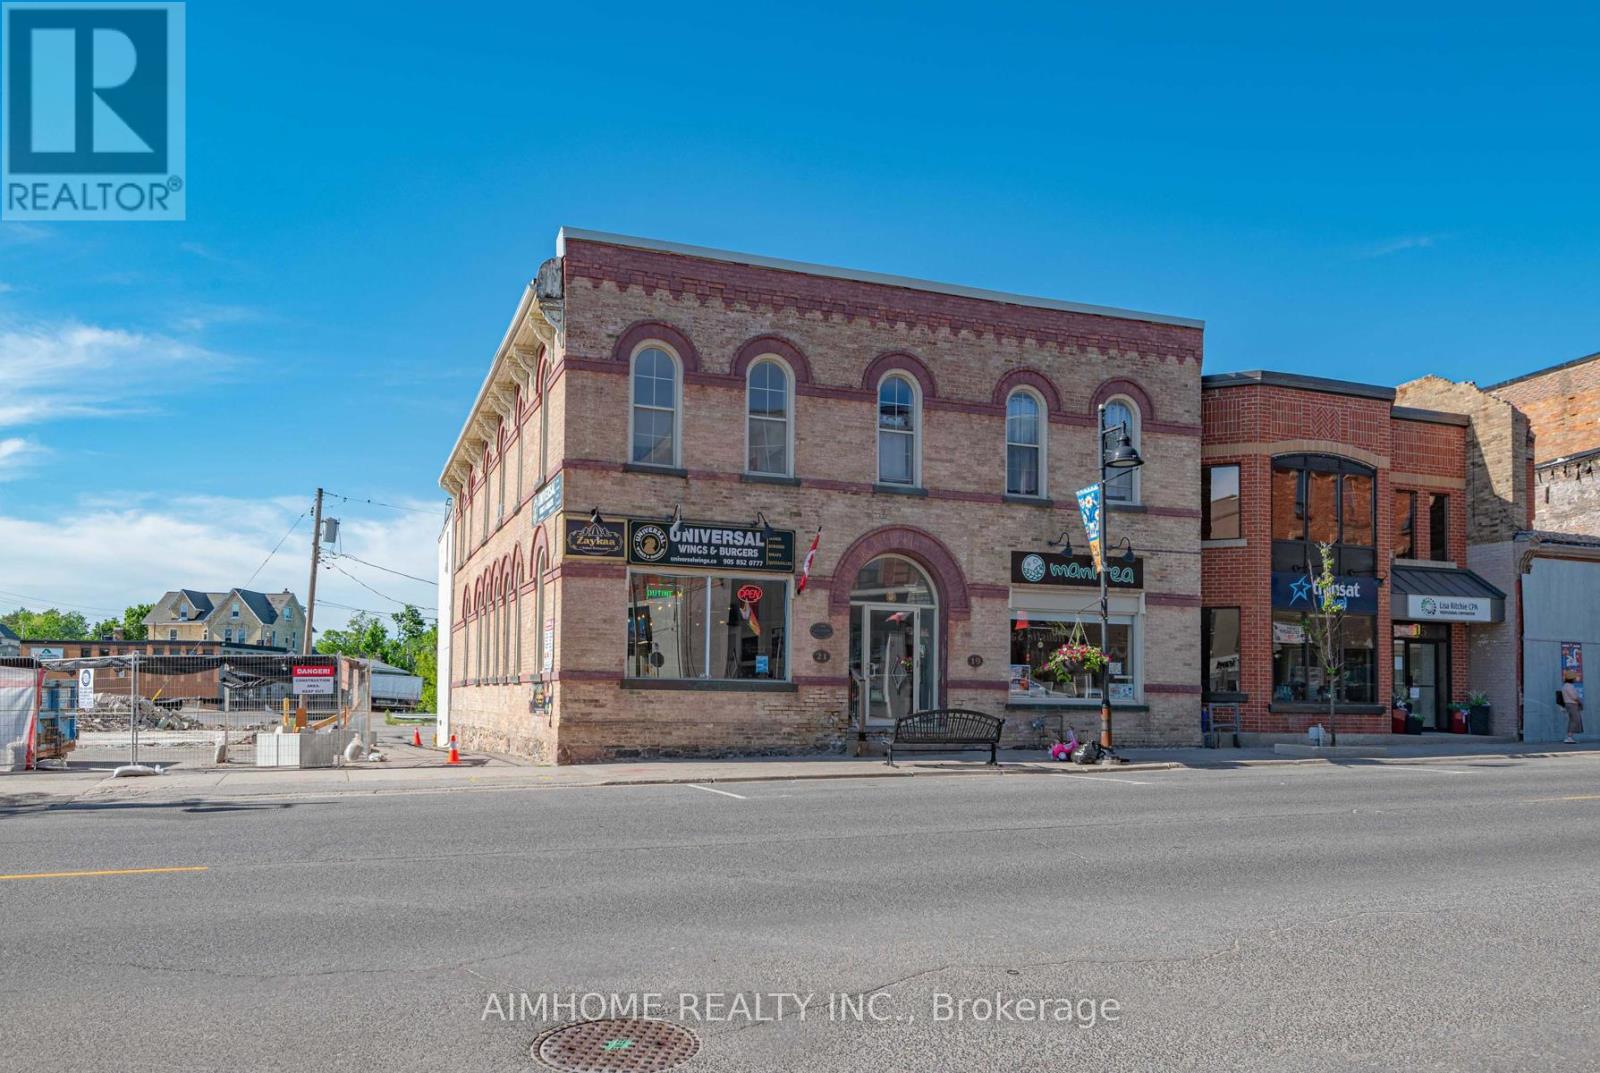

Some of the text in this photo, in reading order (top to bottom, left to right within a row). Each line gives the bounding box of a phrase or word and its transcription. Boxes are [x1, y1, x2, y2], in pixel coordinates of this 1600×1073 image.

[576, 535, 616, 547] Zaykaa
[634, 526, 666, 544] UNIVERSAL
[669, 527, 765, 547] UNIVERSAL
[678, 544, 759, 557] WINGS & BURGERS
[1049, 561, 1134, 584] maniea
[740, 588, 761, 598] OPEN
[1313, 580, 1360, 597] trnsat
[1318, 595, 1347, 609] Tvel
